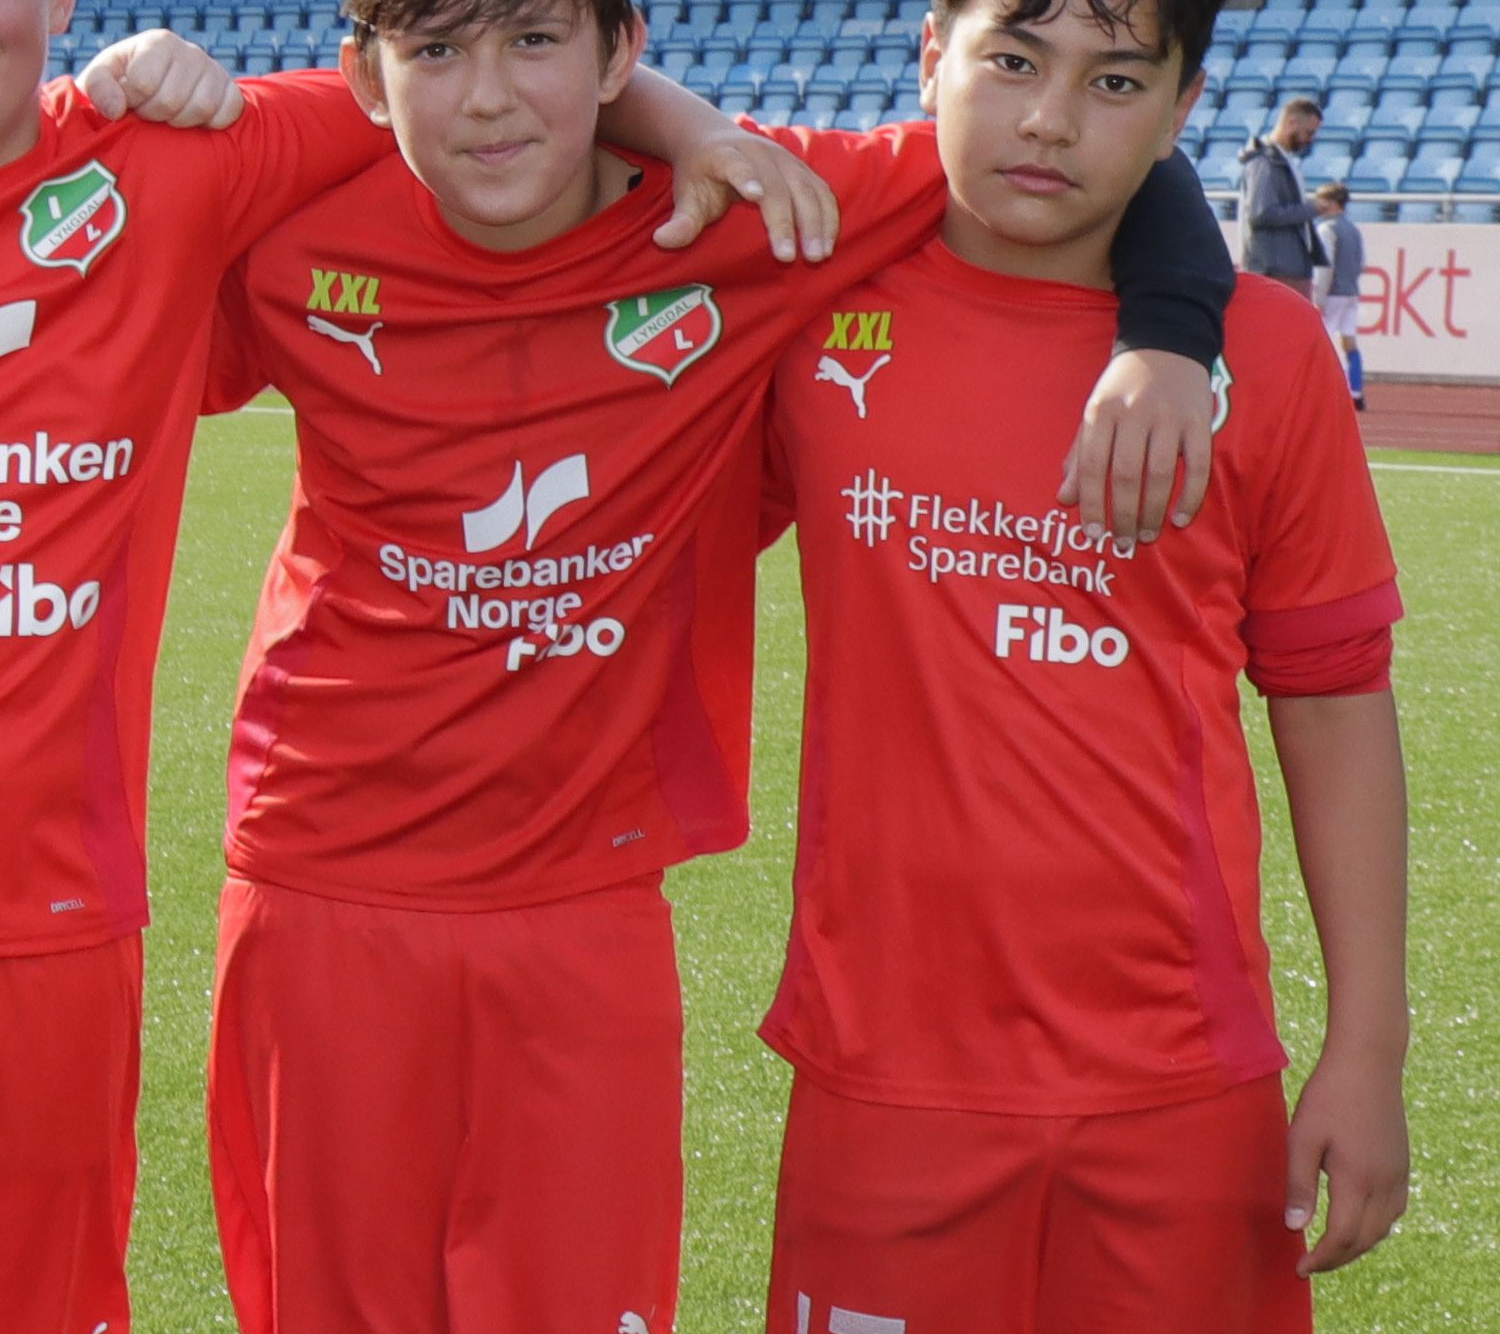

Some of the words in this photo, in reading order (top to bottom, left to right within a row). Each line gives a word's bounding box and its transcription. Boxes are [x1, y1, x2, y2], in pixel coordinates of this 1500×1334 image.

[48, 199, 104, 247] LYNGDAL
[307, 268, 381, 315] XXL
[631, 301, 694, 345] LYNGDAL
[823, 311, 893, 350] XXL
[908, 535, 1118, 597] Sparebank
[447, 590, 582, 636] Norge
[994, 603, 1130, 669] Fibo
[506, 616, 626, 673] Fbo
